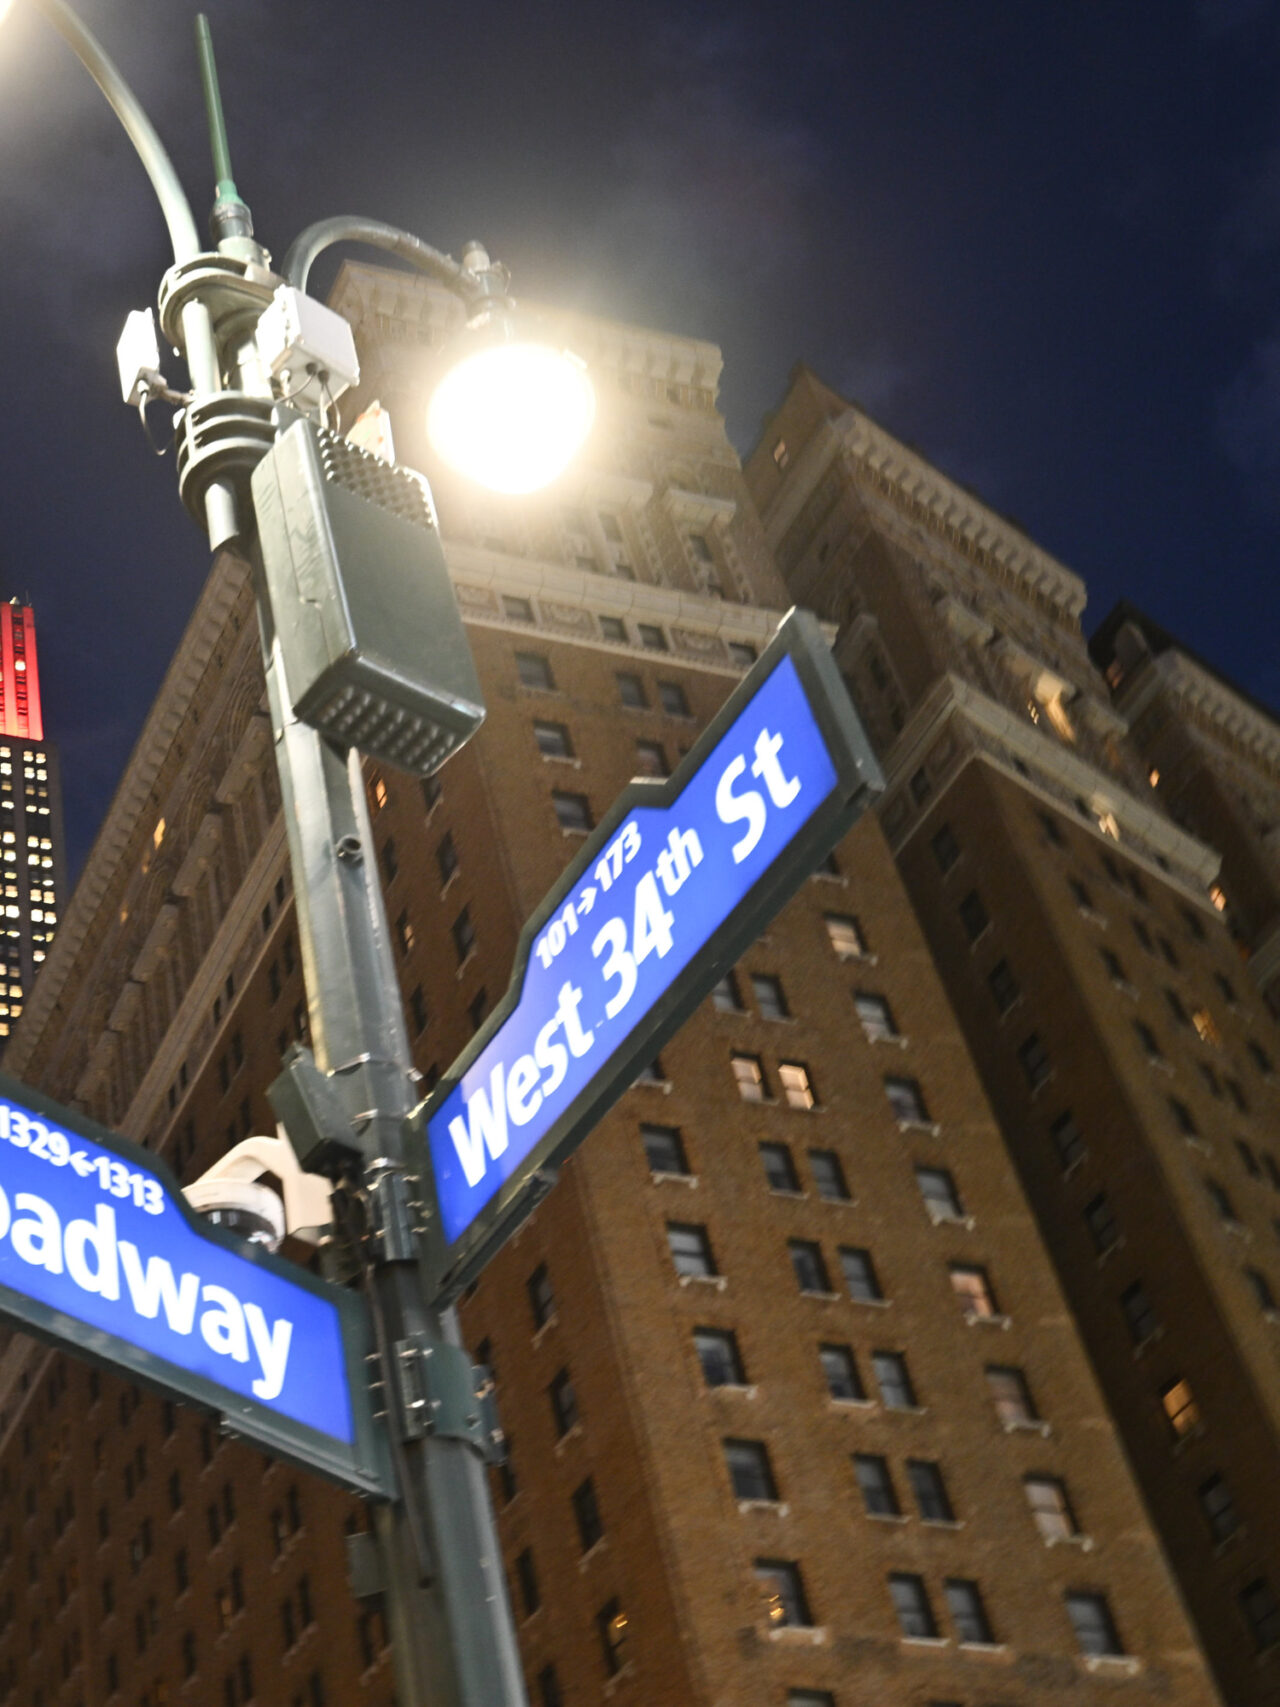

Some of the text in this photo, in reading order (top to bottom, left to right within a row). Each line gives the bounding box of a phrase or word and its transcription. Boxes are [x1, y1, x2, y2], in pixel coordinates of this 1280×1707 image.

[447, 728, 802, 1188] West 34th St
[535, 820, 642, 969] 101 173
[93, 1154, 165, 1216] 1313
